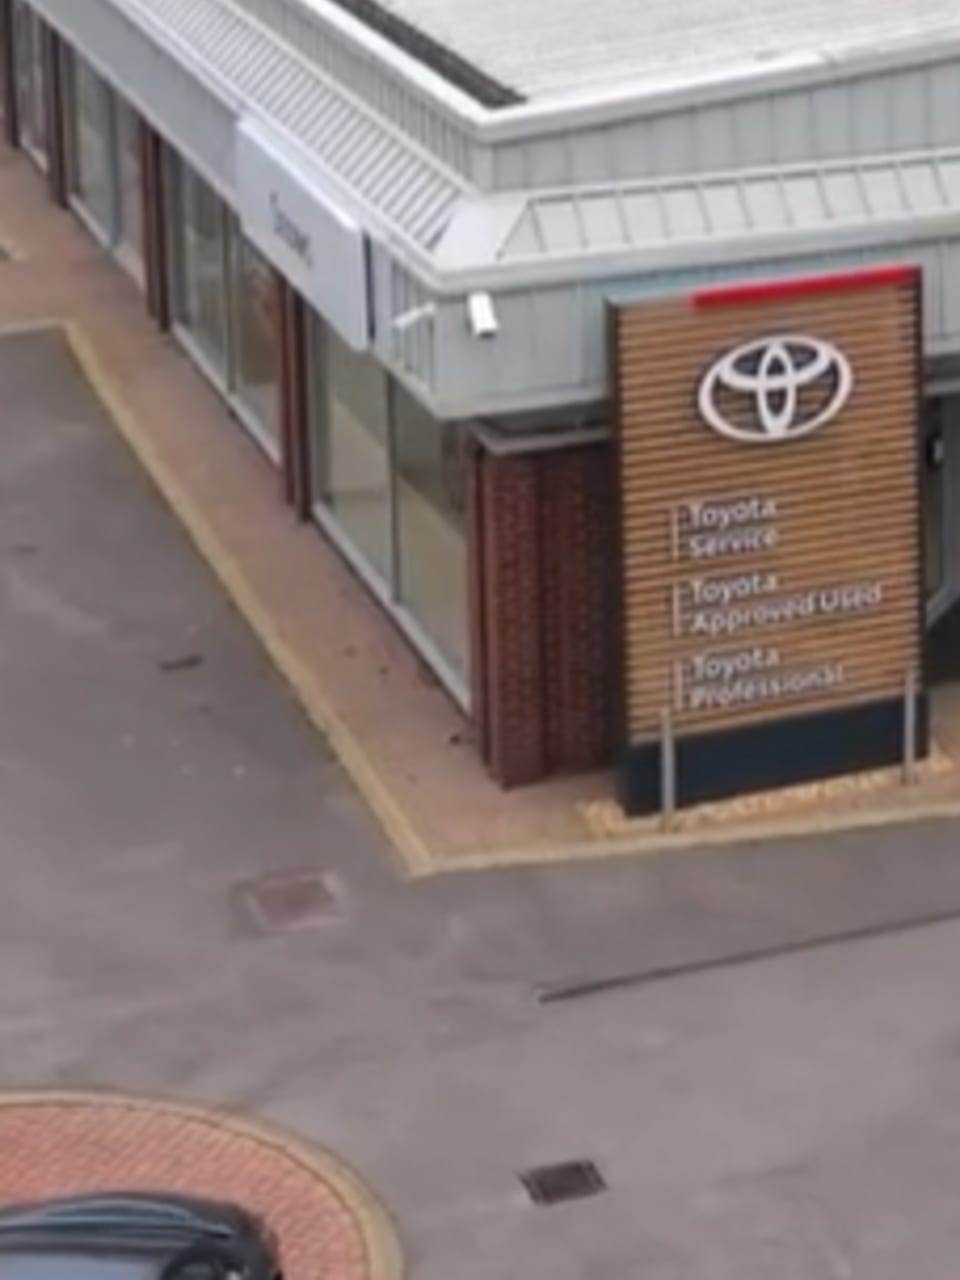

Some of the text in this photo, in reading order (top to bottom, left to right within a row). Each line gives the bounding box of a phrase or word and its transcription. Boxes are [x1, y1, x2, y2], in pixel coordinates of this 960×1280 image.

[690, 498, 776, 530] Toyota
[690, 573, 778, 604] Toyota
[690, 581, 883, 635] Approved Used
[692, 647, 780, 682] Toyota
[690, 665, 845, 708] Professional
